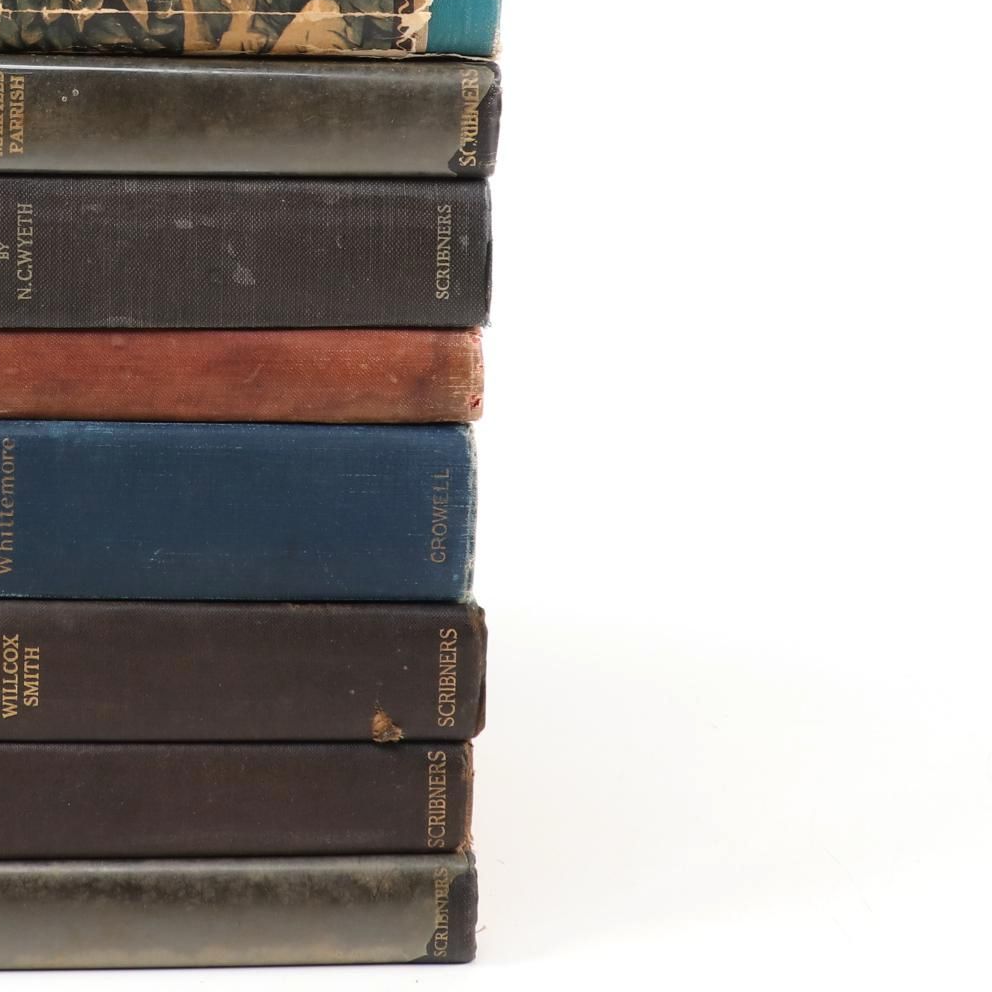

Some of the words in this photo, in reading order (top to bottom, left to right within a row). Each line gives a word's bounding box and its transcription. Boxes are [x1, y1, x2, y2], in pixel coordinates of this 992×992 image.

[10, 75, 25, 154] PARRISH
[459, 68, 479, 167] SCRIBNERS
[436, 204, 451, 299] SCRIBNERS
[431, 469, 450, 564] CROWELL
[2, 634, 20, 719] WILLCOX
[24, 646, 40, 707] SMITH
[438, 627, 458, 728] SCRIBNERS
[428, 750, 446, 848] SCRIBNERS
[434, 867, 448, 959] SCRIBNERS
